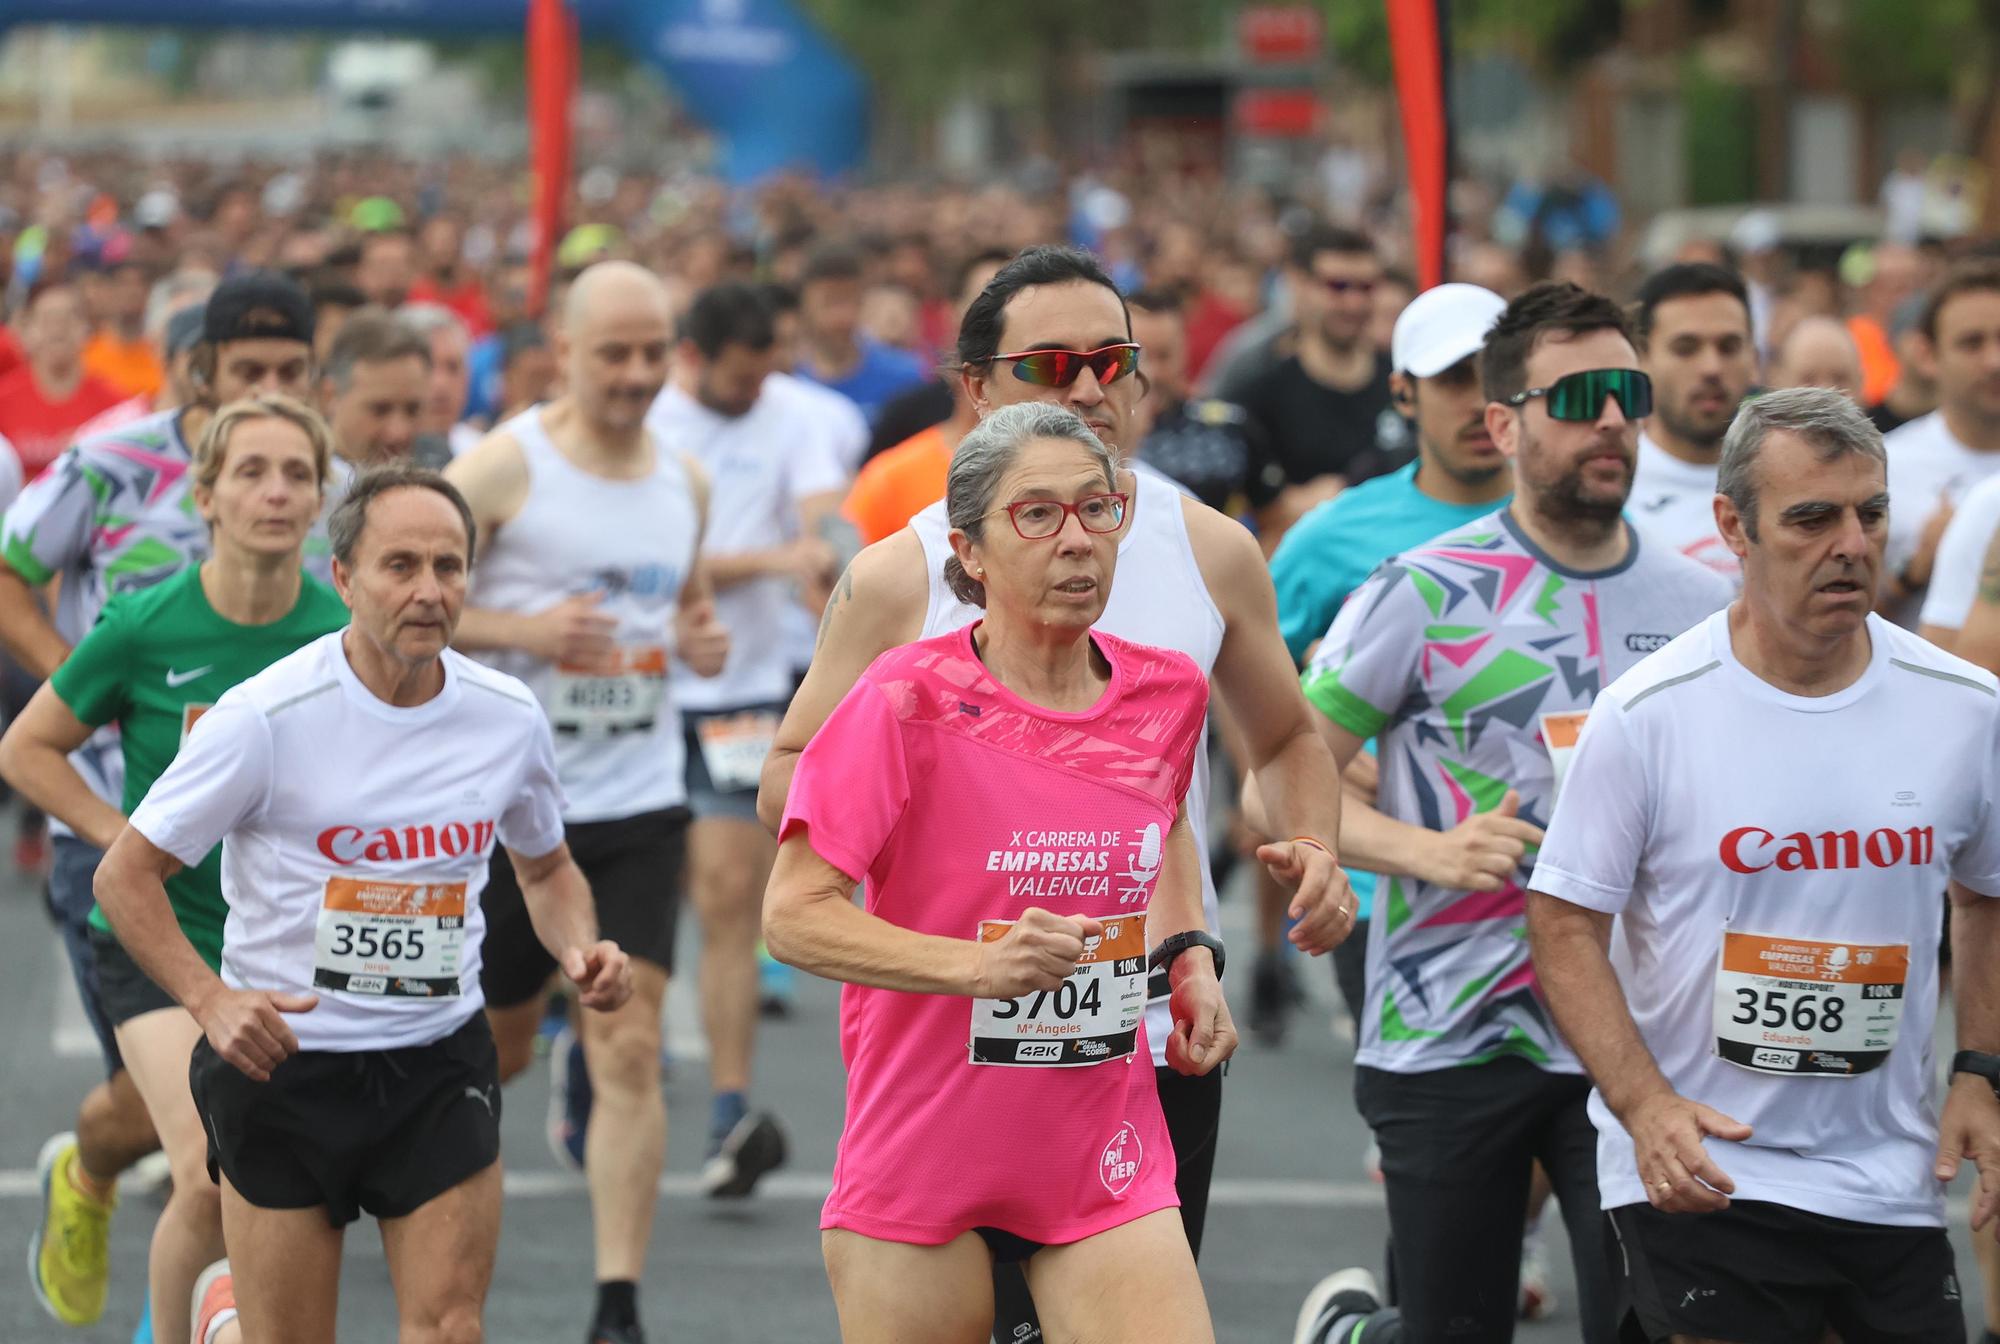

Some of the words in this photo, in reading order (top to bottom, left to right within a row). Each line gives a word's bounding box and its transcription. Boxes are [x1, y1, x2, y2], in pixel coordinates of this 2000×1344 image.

[317, 818, 494, 866] Canon
[1009, 831, 1023, 846] X
[1026, 831, 1096, 847] CARRERA
[1100, 831, 1121, 846] DE
[1719, 826, 1934, 874] Canon
[986, 851, 1109, 872] EMPRESAS
[1009, 876, 1109, 896] VALENCIA
[1105, 926, 1119, 940] 10
[331, 925, 424, 960] 3565
[1119, 958, 1138, 974] 10K
[1867, 985, 1895, 997] 10K
[1733, 988, 1845, 1033] 3568
[1036, 1022, 1081, 1037] Ángeles
[1763, 1032, 1812, 1045] Eduardo
[1020, 1046, 1059, 1057] 42K
[1757, 1053, 1795, 1065] 42K
